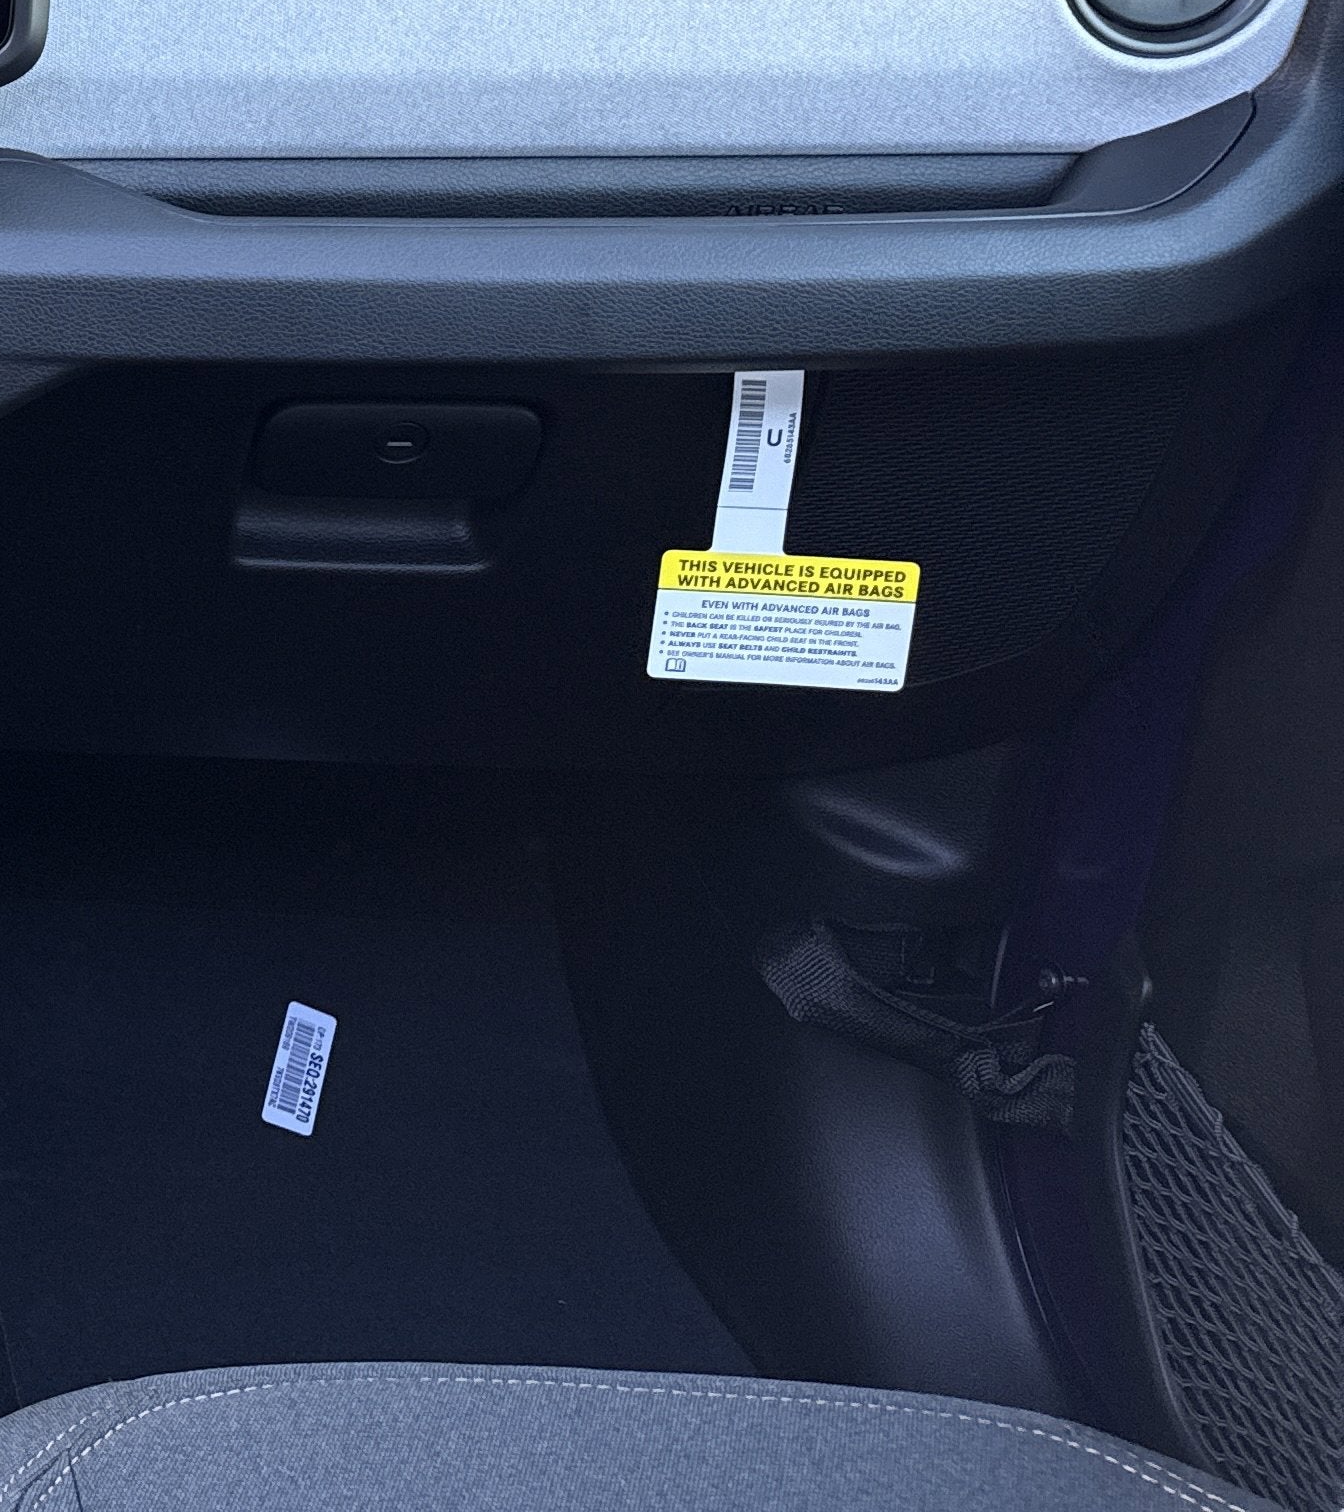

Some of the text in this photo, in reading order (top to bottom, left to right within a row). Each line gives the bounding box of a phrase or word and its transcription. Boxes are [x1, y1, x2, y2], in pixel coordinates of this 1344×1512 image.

[767, 428, 783, 447] U
[679, 559, 907, 583] THIS VEHICLE IS EQUIPPED
[677, 574, 905, 598] WITH ADVANCED AIR BAGS
[701, 599, 871, 618] EVEN WITH ADVANCED AIR BAGS
[668, 640, 701, 648] ALWAYS
